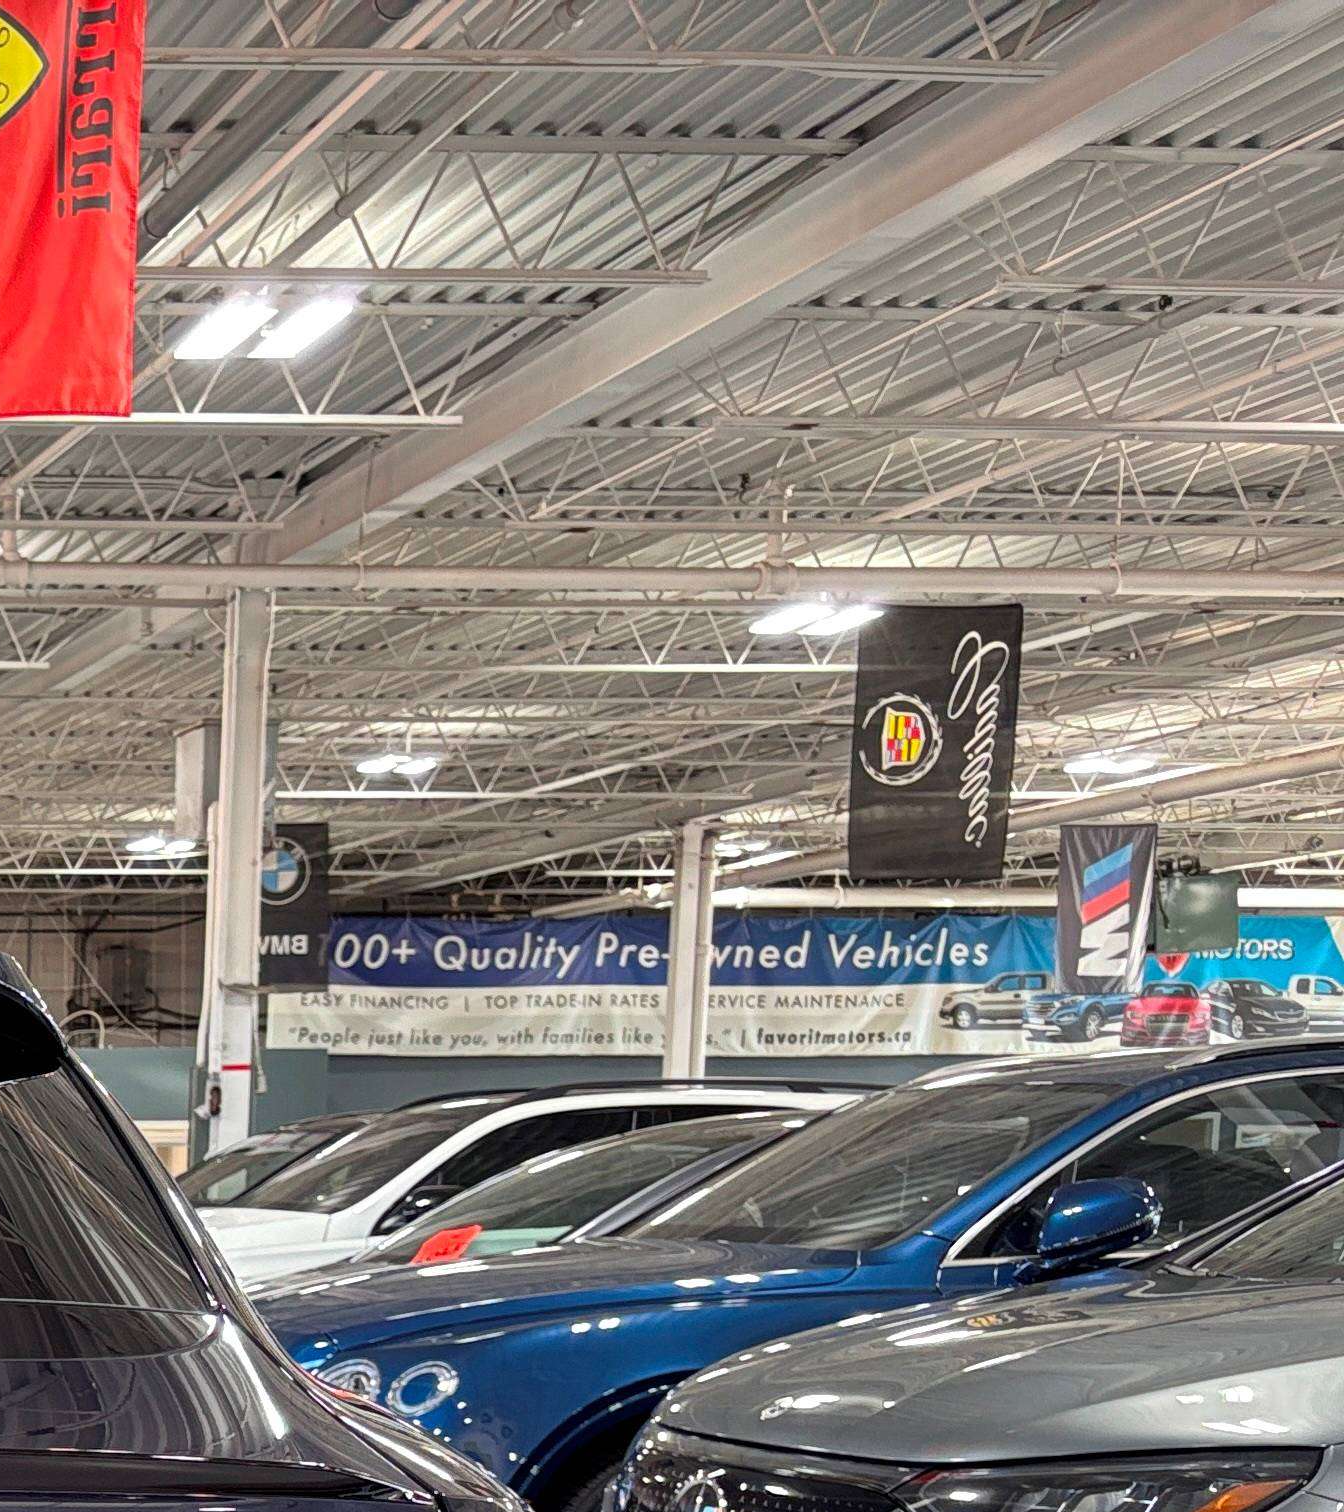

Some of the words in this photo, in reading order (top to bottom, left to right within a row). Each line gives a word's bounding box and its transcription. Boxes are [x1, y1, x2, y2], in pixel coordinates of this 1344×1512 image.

[433, 931, 580, 980] Quality
[827, 927, 990, 969] Vehicles
[300, 992, 345, 1006] EASY
[350, 994, 449, 1010] FINANCING
[484, 994, 519, 1010] TOP
[610, 993, 660, 1009] RATES
[707, 994, 766, 1010] ERVICE
[774, 993, 905, 1009] MAINTENANCE
[367, 1029, 403, 1048] just
[408, 1026, 444, 1046] like
[496, 1028, 535, 1046] with
[541, 1027, 615, 1046] families
[621, 1026, 654, 1044] like
[756, 1027, 912, 1046] favoritmotors.ca
